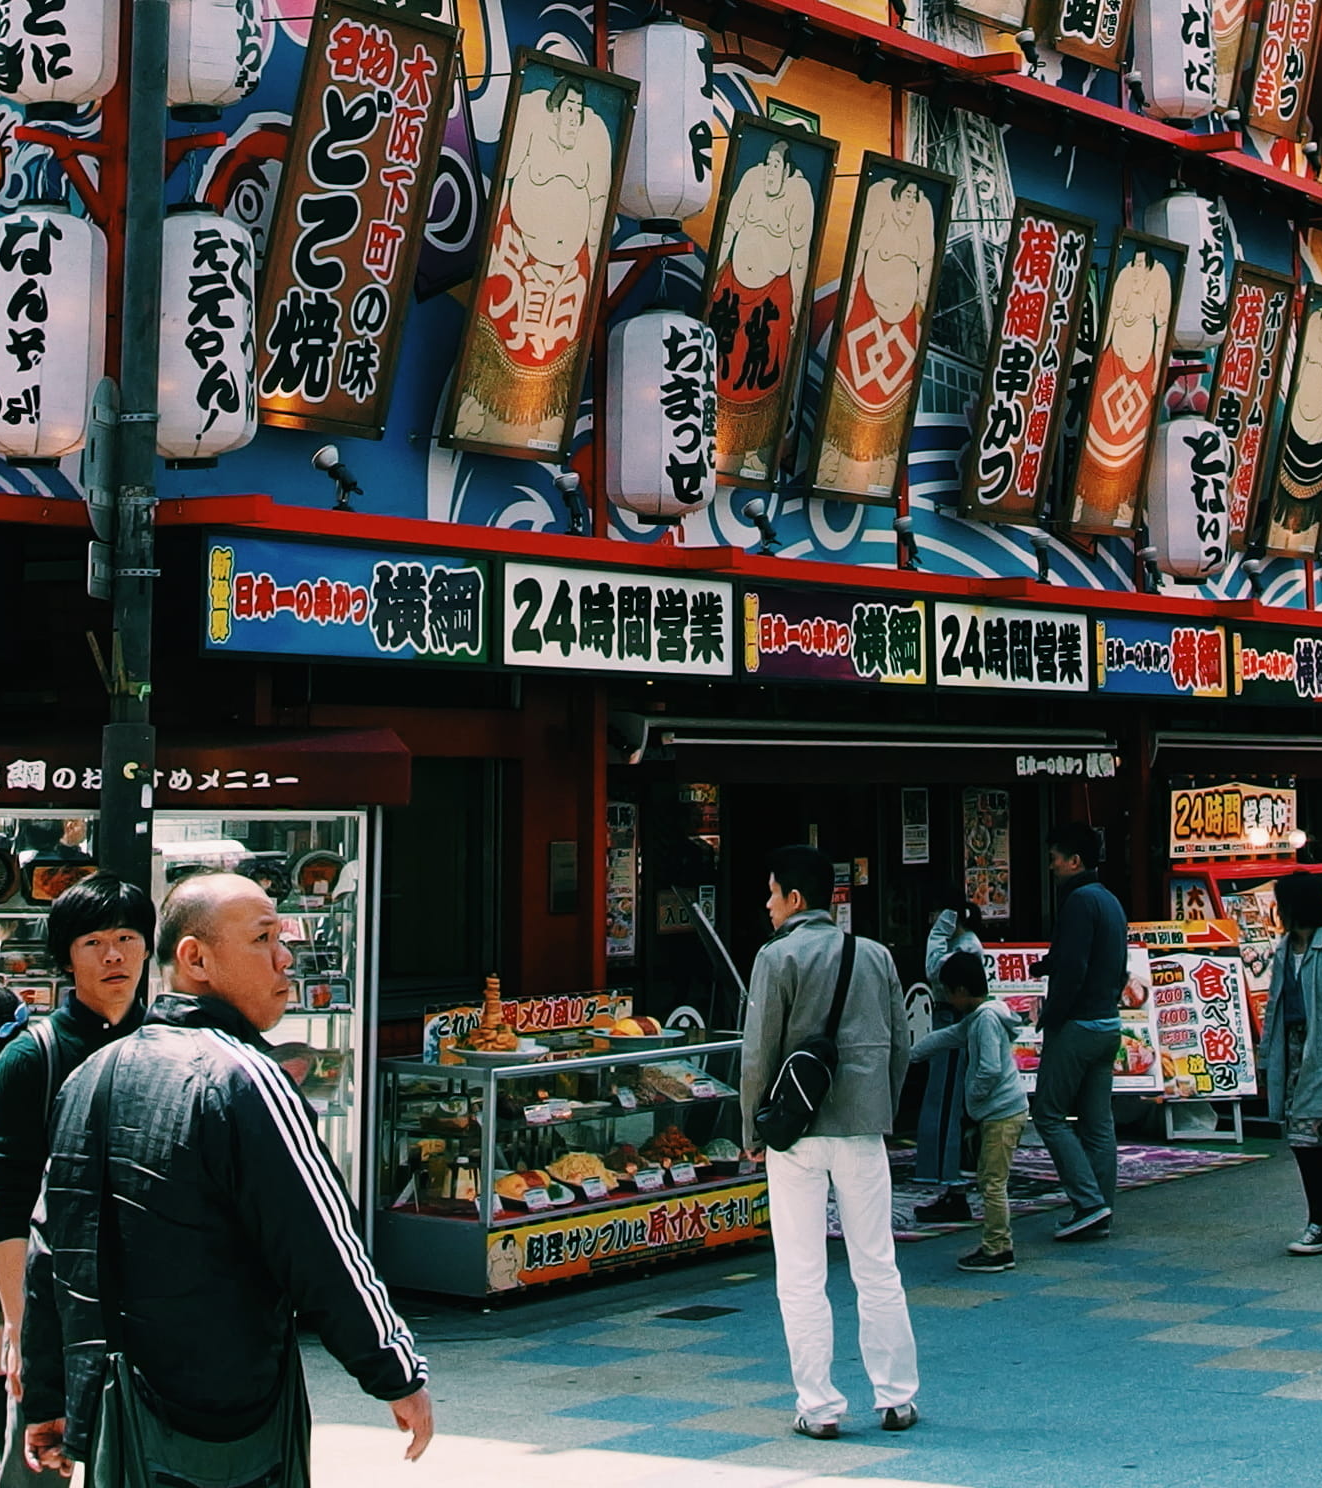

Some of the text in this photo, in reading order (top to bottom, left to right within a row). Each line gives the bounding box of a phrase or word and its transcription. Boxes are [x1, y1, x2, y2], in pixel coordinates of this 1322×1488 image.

[326, 16, 397, 89] 名物
[338, 43, 437, 405] 大阪下町の味
[977, 214, 1059, 507] 横綱串かつ
[233, 561, 483, 655] 日本一の串かつ 横綱
[511, 577, 726, 665] 24時間営業
[759, 602, 922, 680] 日本一の串かつ 横綱
[940, 613, 1085, 687] 24時間営業
[1105, 624, 1225, 690] 日本一の串かつ 横綱
[1174, 789, 1288, 840] 24時間営業中
[1190, 960, 1239, 1090] 食べ飲み
[524, 1194, 751, 1272] 料理サンプルは原寸大です!!
